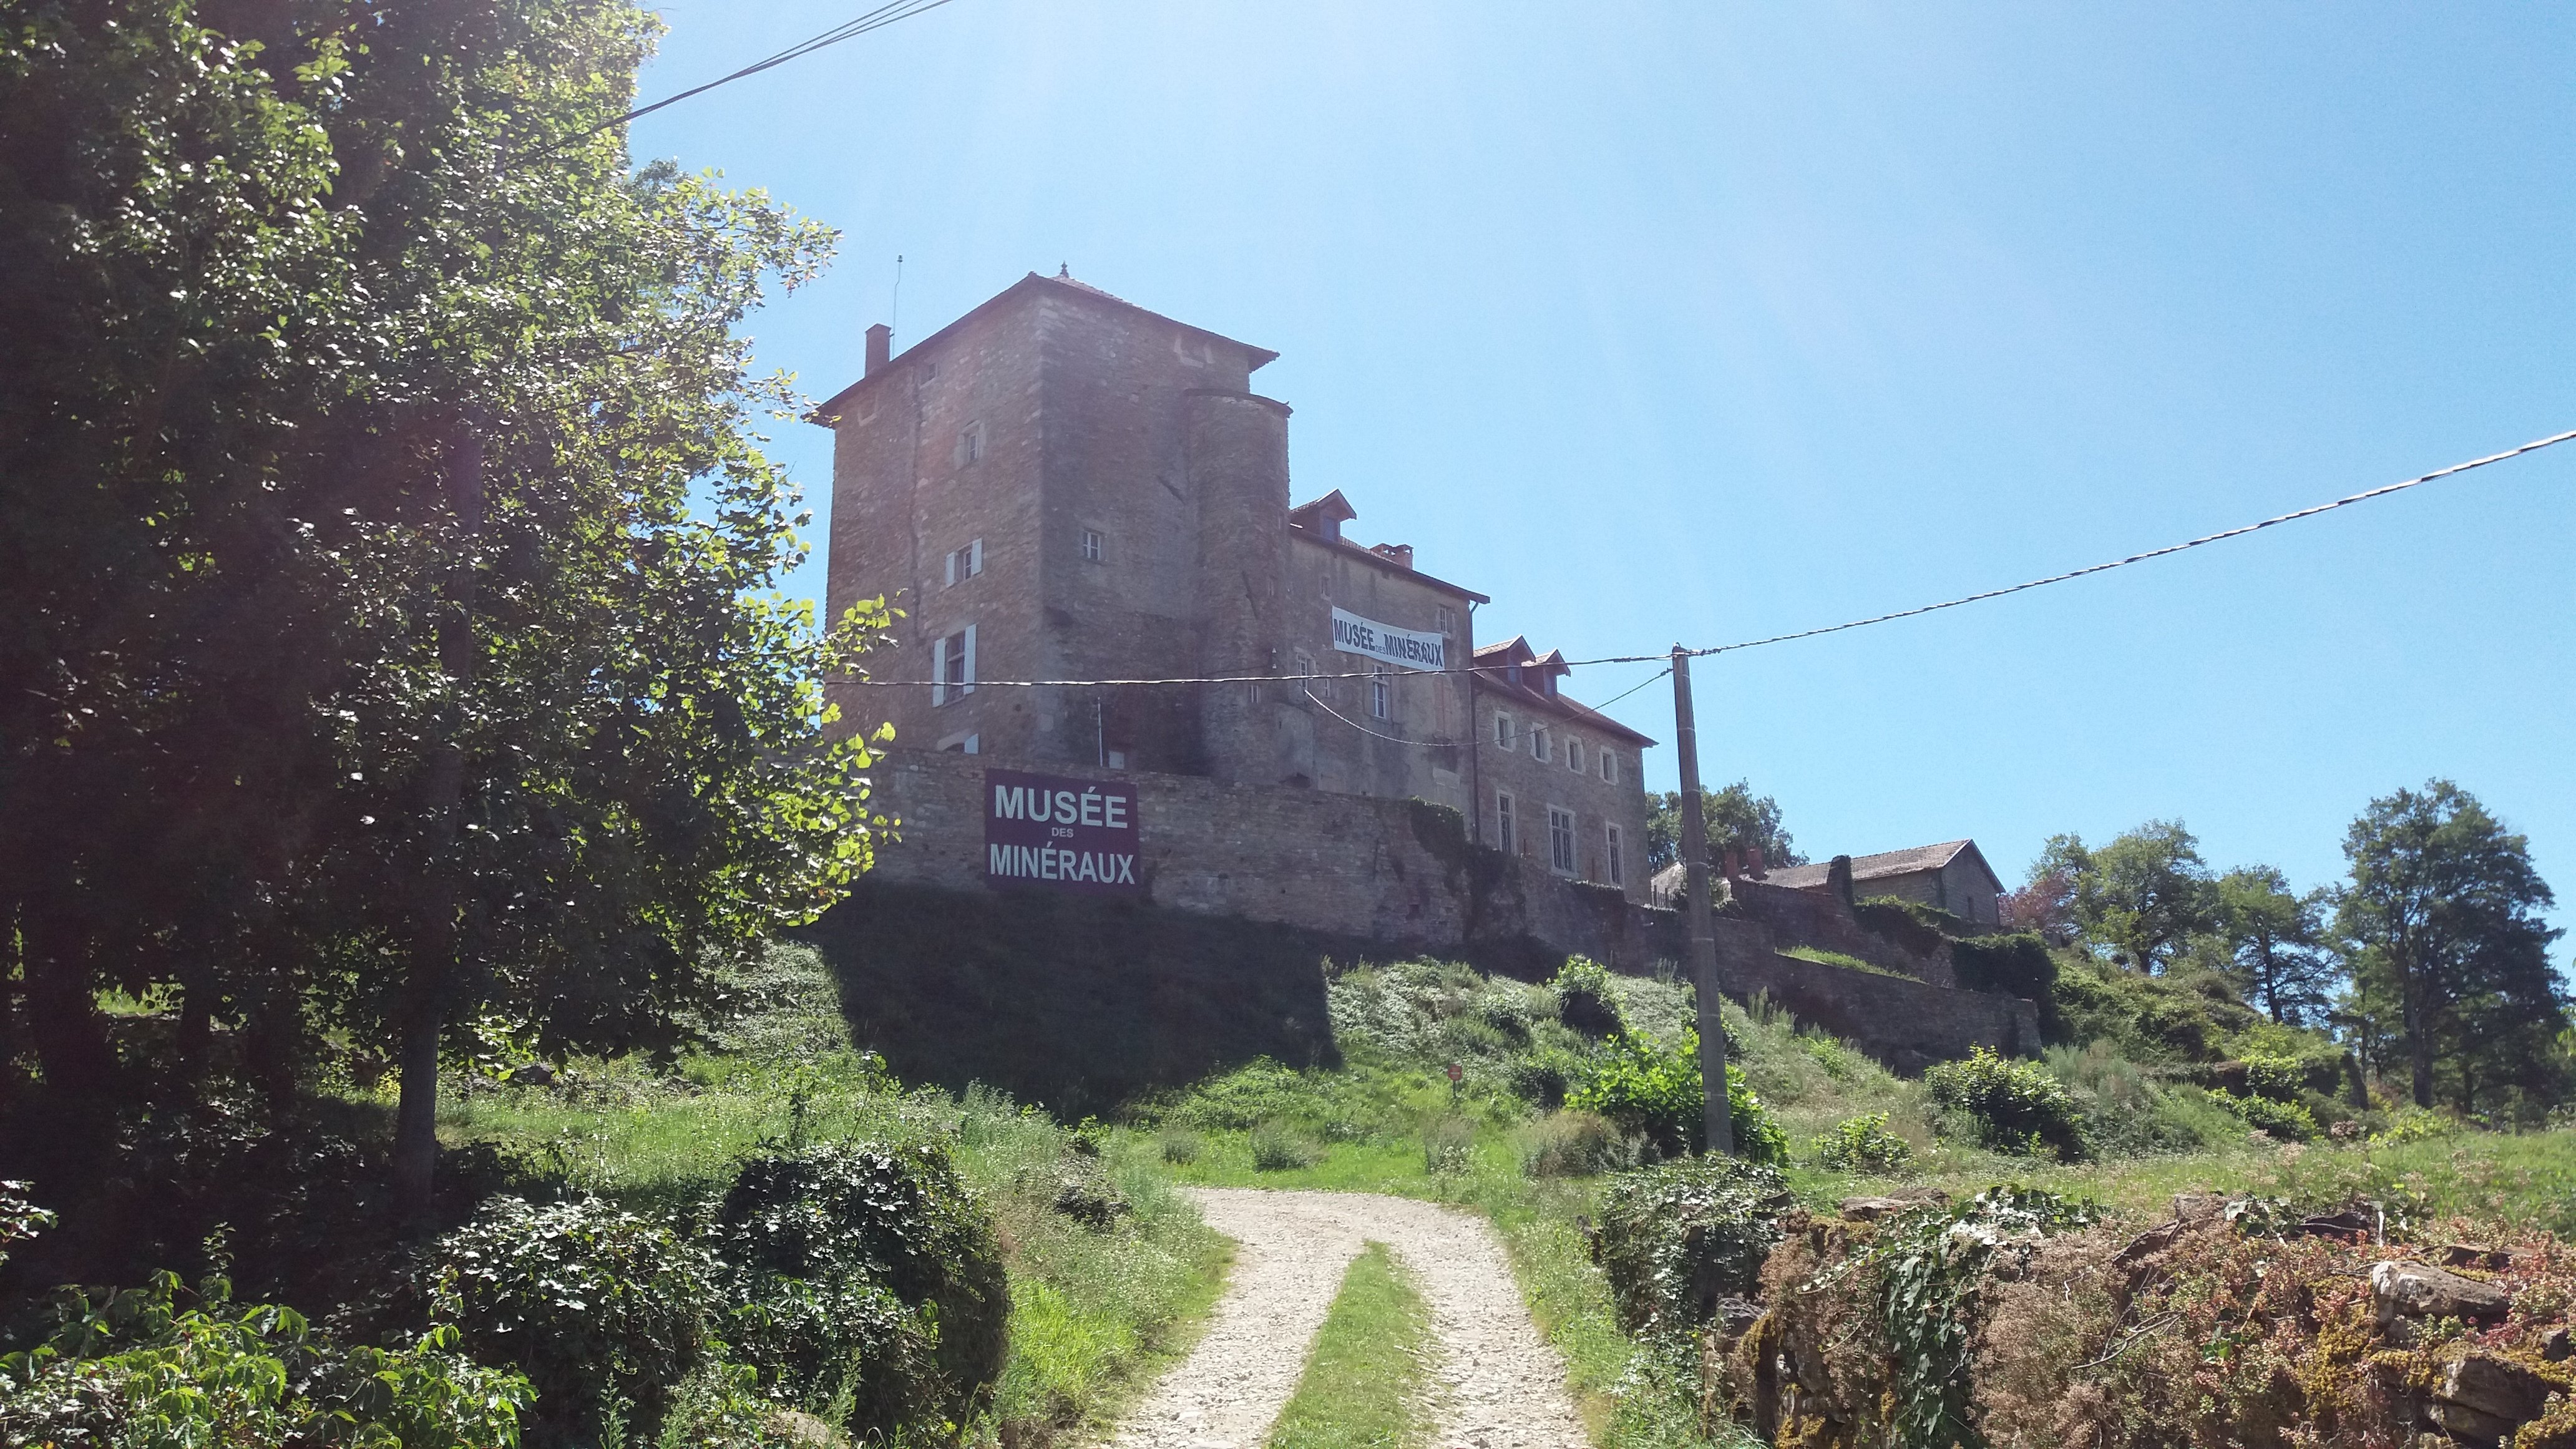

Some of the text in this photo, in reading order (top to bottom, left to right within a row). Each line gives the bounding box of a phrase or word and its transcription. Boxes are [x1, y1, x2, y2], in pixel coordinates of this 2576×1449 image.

[1334, 618, 1443, 667] MUSÉE DES MINÉRAUX
[995, 784, 1128, 829] MUSÉE
[1051, 827, 1074, 838] DES
[990, 841, 1135, 885] MINÉRAUX
